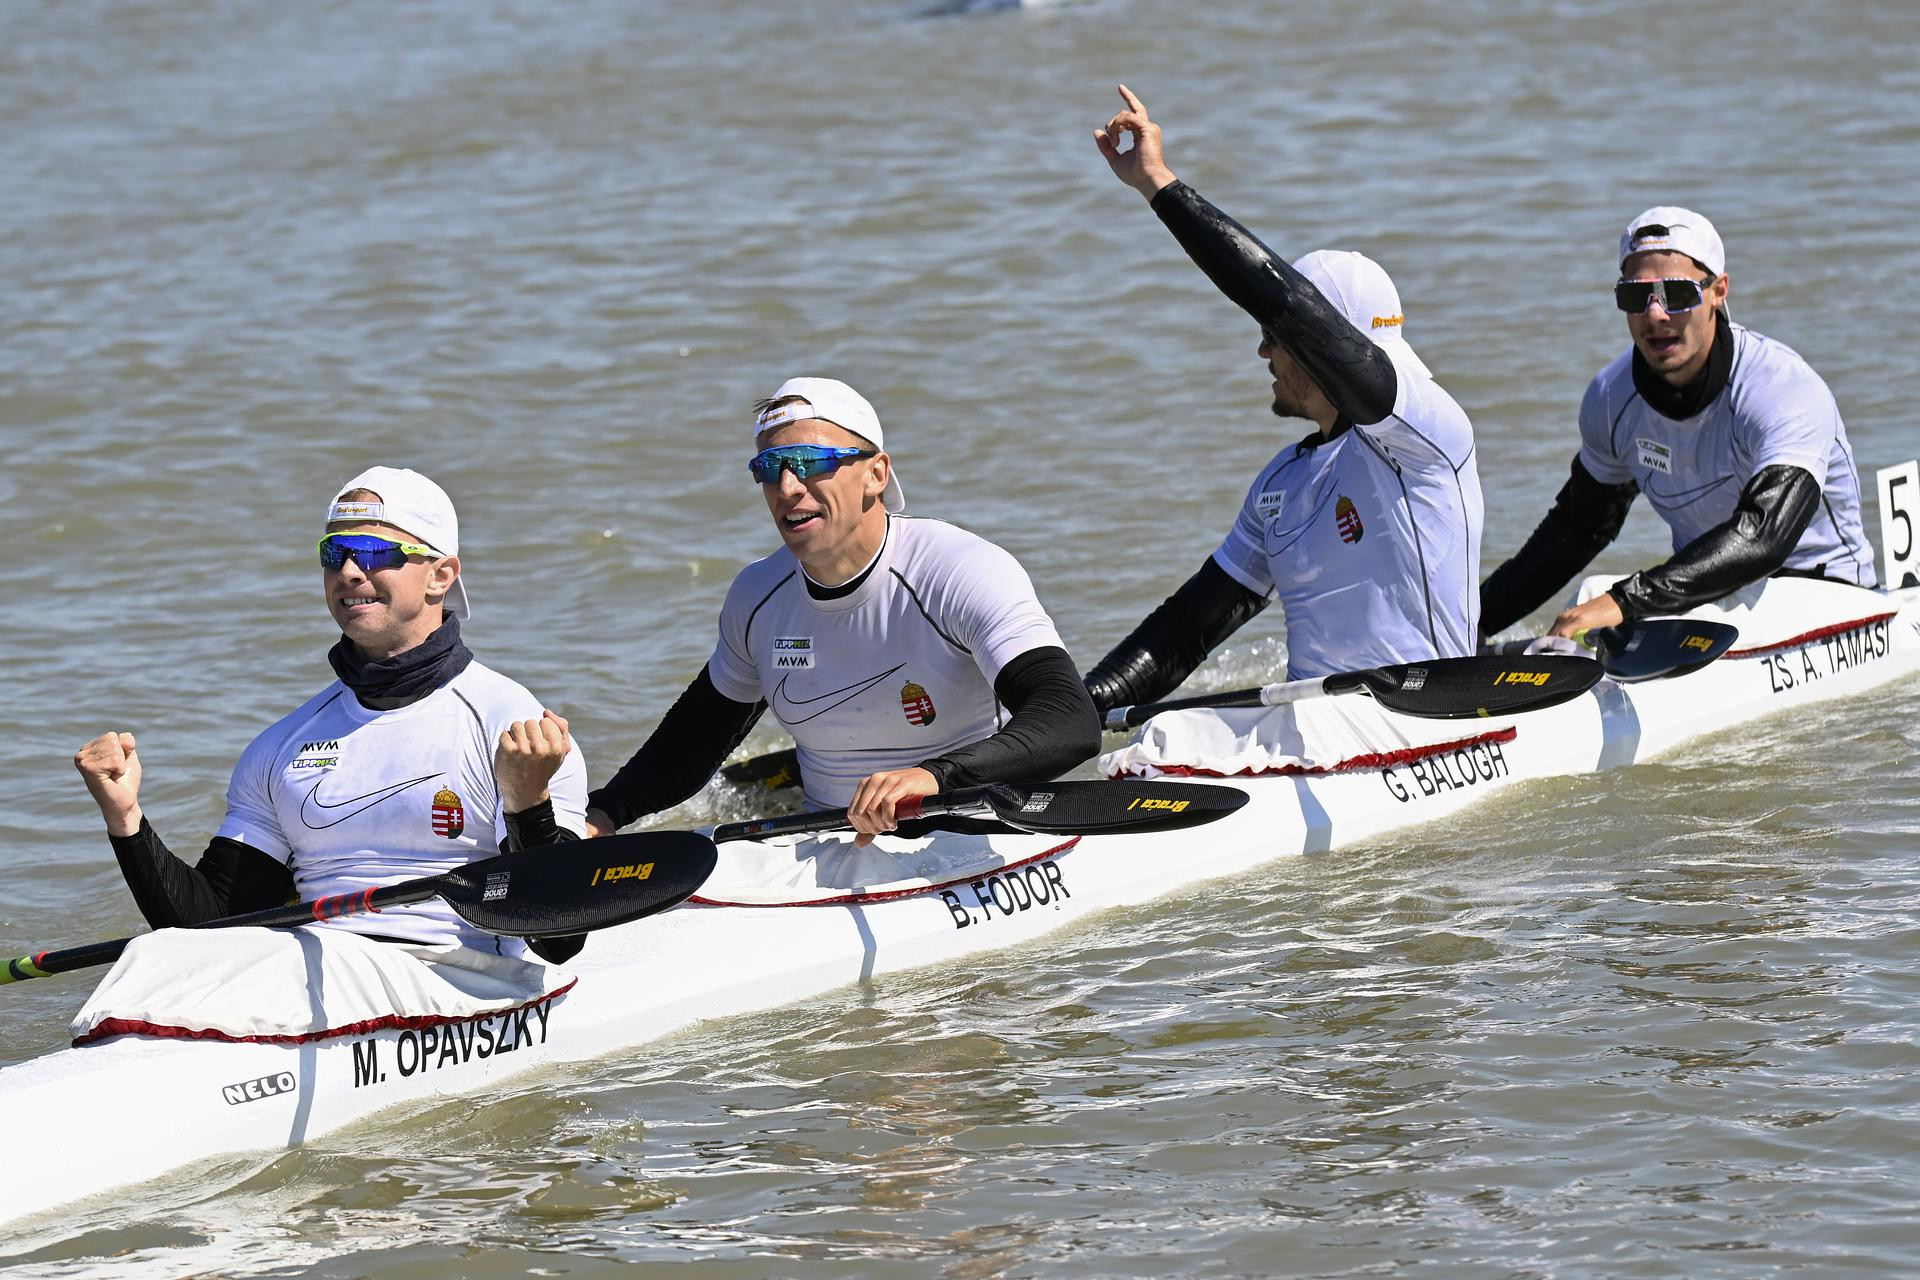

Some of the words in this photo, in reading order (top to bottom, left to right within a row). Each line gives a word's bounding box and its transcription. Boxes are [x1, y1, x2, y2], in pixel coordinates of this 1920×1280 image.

[1643, 455, 1668, 471] MVM
[1260, 493, 1281, 505] MVM
[1889, 475, 1913, 562] 5
[777, 656, 809, 667] MVM
[1760, 654, 1799, 694] ZS.
[1800, 647, 1822, 684] A.
[300, 740, 339, 753] MVM
[1381, 768, 1416, 803] G.
[1409, 742, 1509, 797] BALOGH
[483, 887, 508, 898] canoe
[938, 889, 978, 930] B.
[970, 860, 1071, 921] FODOR
[352, 1038, 386, 1089] M.
[396, 998, 552, 1078] OPAVSZKY
[222, 1071, 296, 1106] NELO
